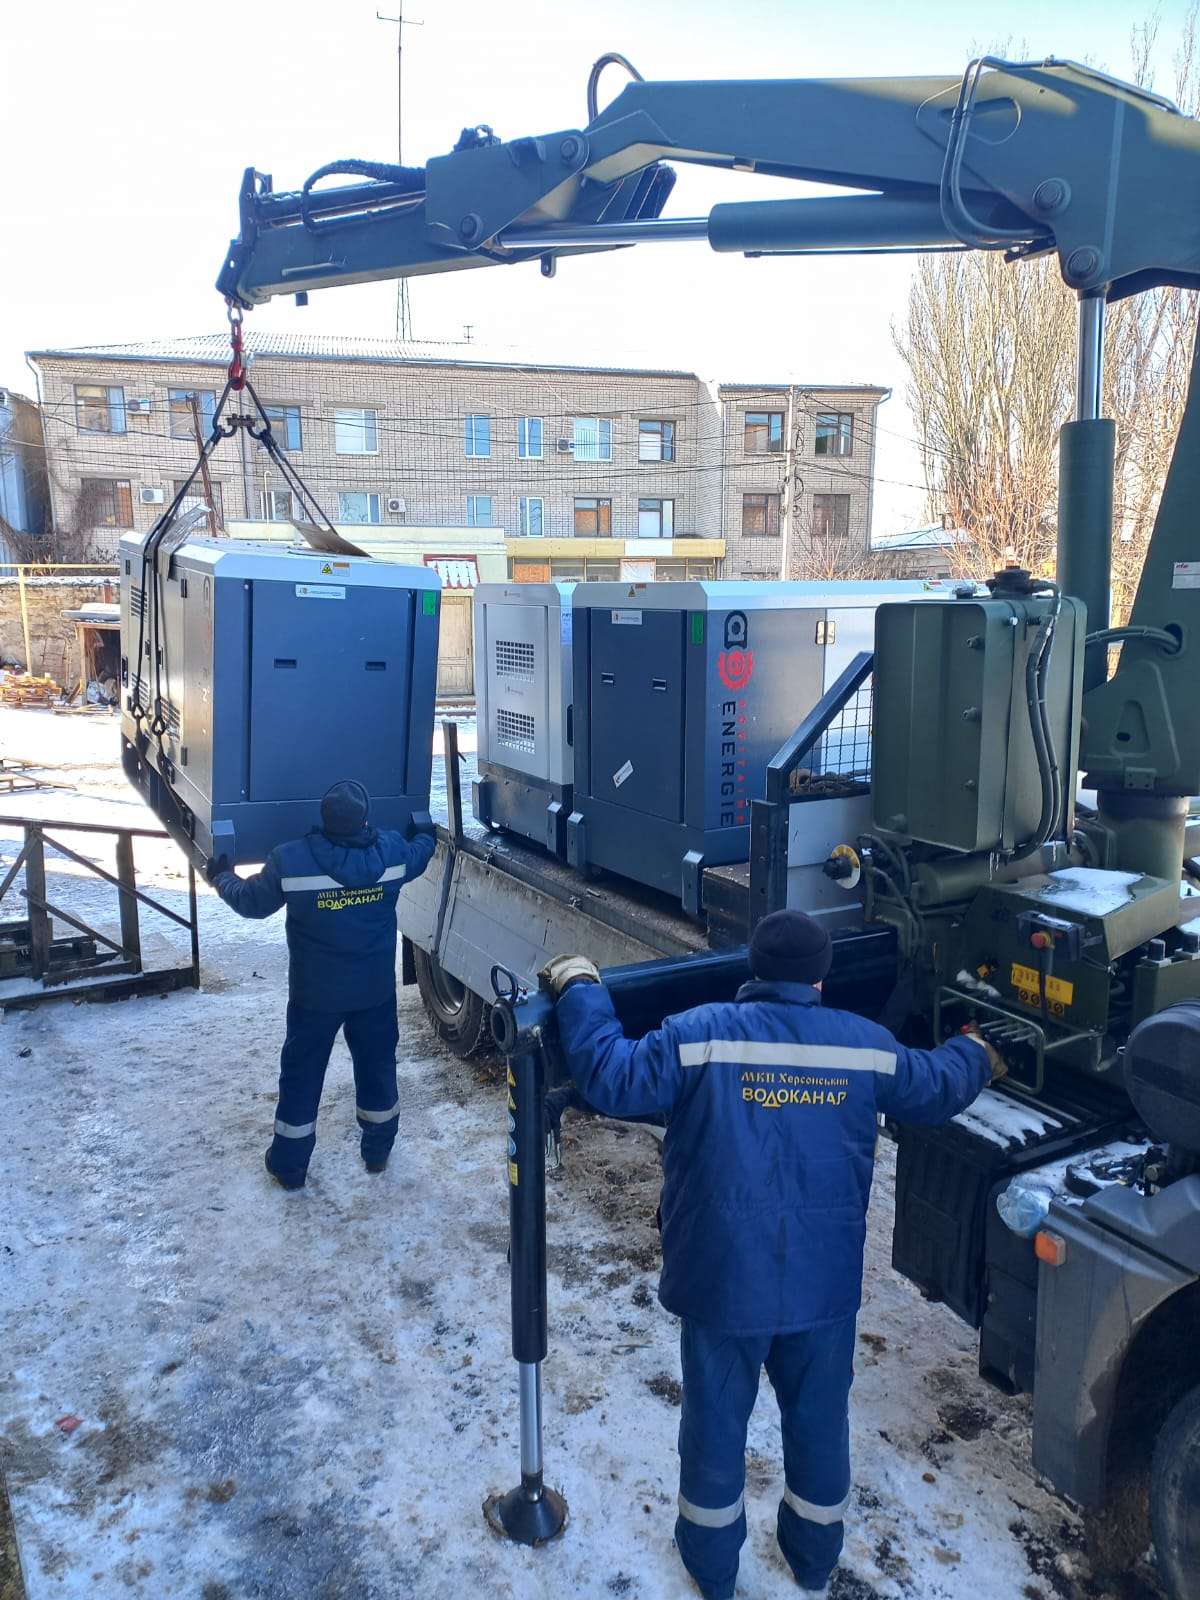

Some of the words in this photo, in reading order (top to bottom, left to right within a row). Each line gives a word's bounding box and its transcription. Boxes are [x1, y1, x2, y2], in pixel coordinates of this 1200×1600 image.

[721, 701, 736, 826] ENERGIE
[317, 893, 384, 910] ВОДОКАНАЛ
[741, 1071, 775, 1083] МКП
[742, 1087, 847, 1107] ВОДОКАНАЛ
